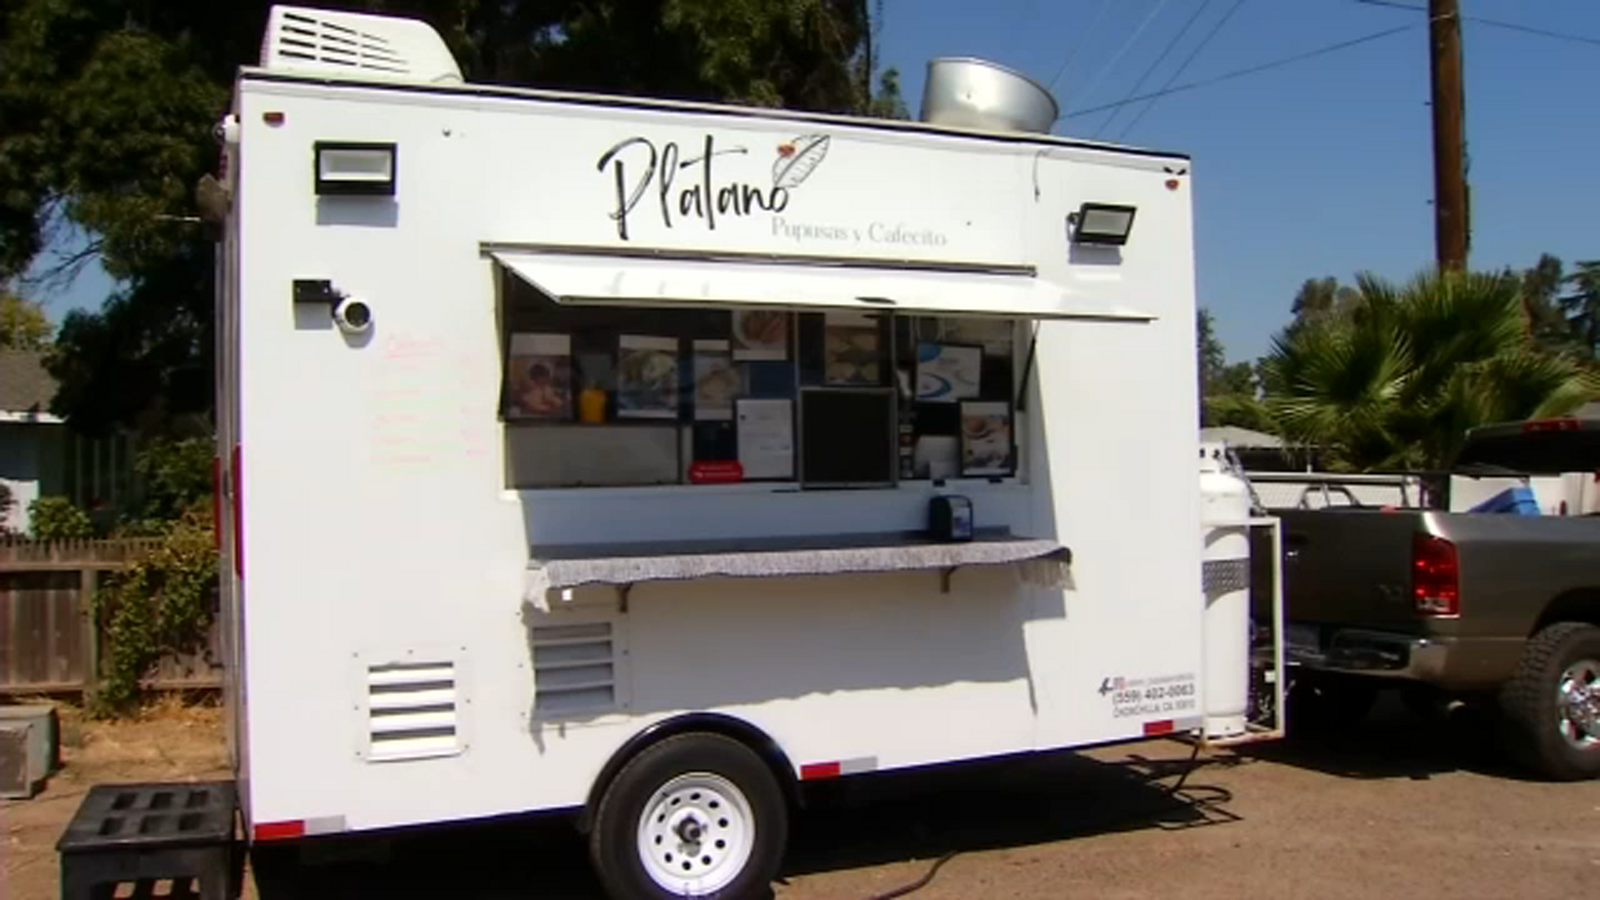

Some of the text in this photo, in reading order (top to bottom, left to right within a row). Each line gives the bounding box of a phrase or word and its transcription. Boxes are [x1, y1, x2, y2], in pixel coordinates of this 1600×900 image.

[597, 135, 789, 240] Platano
[771, 216, 947, 247] Pupusas y Cafecito
